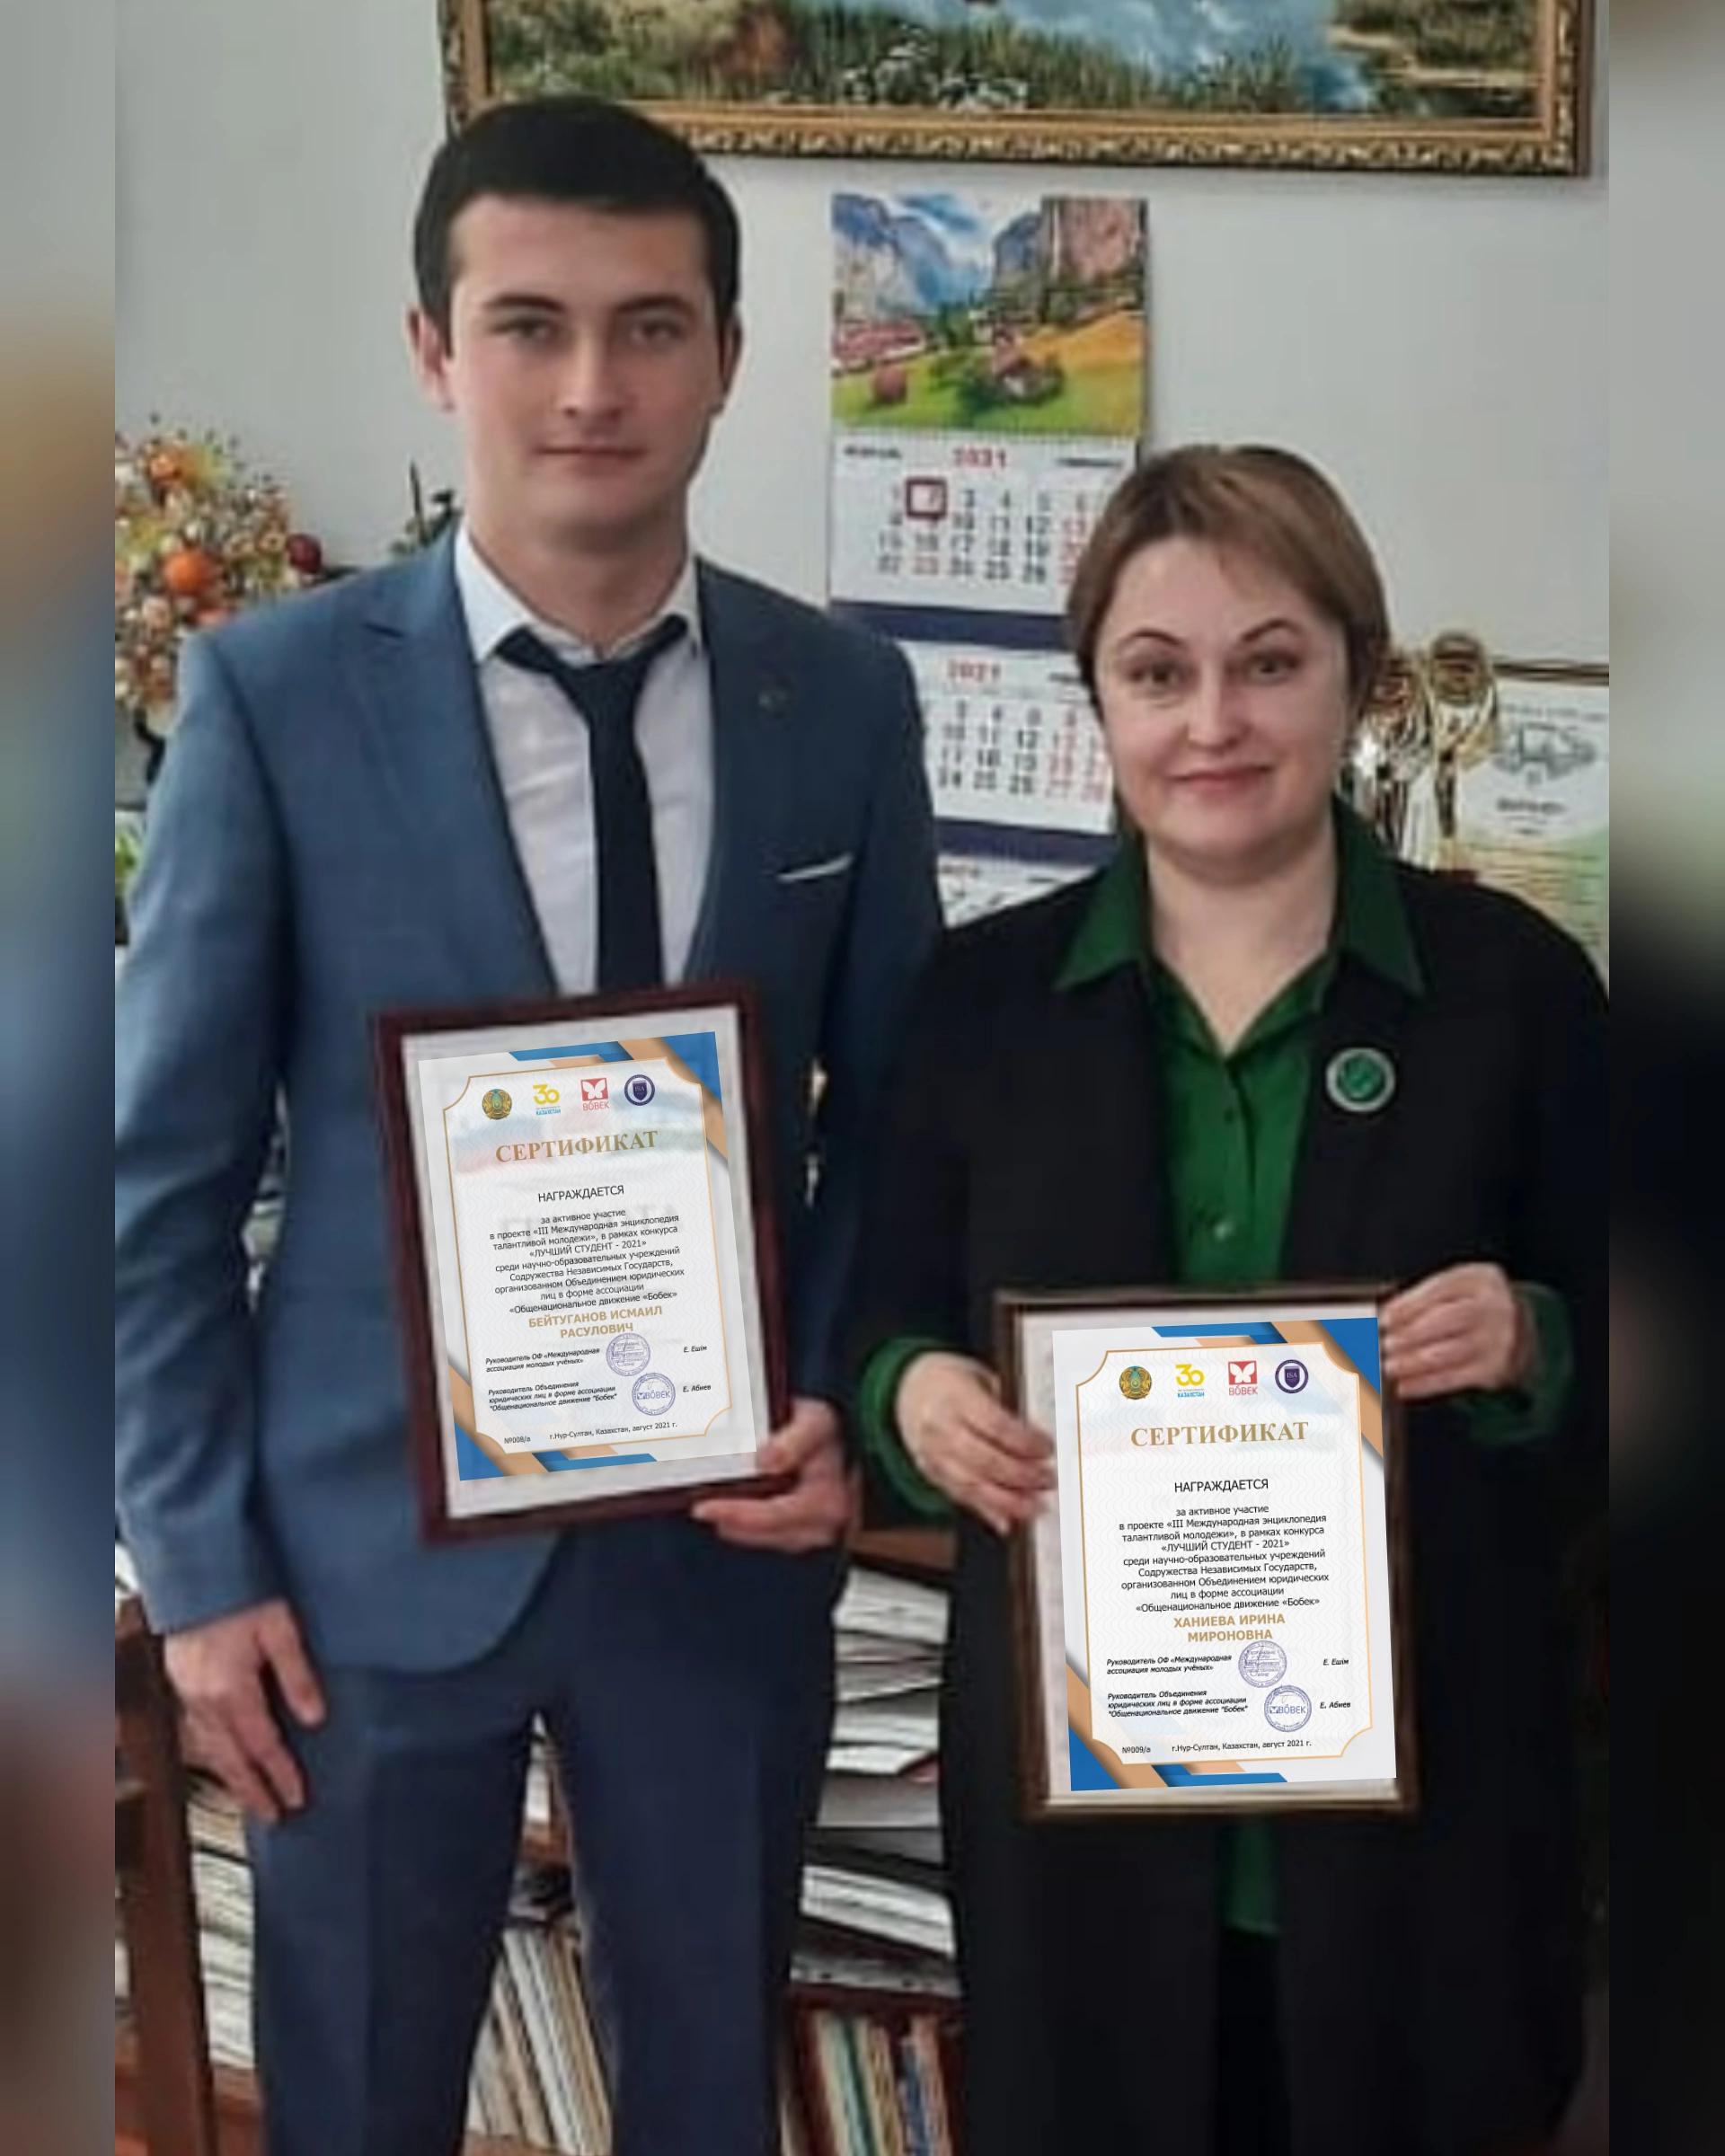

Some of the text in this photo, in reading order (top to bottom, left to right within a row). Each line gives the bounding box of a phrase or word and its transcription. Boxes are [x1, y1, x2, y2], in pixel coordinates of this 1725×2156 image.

[952, 446, 1006, 468] 2021
[494, 1129, 659, 1163] СЕРТИФИКАТ
[537, 1184, 624, 1203] НАГРАЖДАЕТСЯ
[552, 1213, 591, 1224] активное
[592, 1208, 626, 1221] участие
[496, 1229, 531, 1241] проекте
[550, 1221, 618, 1234] Международная
[619, 1215, 679, 1227] энциклопедия
[492, 1237, 546, 1250] талантливой
[547, 1234, 598, 1245] молодежи»,
[607, 1229, 639, 1241] рамках
[639, 1225, 678, 1236] конкурса
[528, 1245, 572, 1258] «ЛУЧШИЙ
[573, 1241, 613, 1254] СТУДЕНТ
[621, 1239, 647, 1250] 2021»
[494, 1245, 680, 1274] среди научно-образовательных учреждений
[509, 1259, 673, 1282] Содружества Независимых Государств,
[494, 1268, 685, 1295] организованном Объединением юридических
[540, 1292, 557, 1301] лиц
[564, 1287, 594, 1299] форме
[595, 1283, 645, 1295] ассоциации
[509, 1291, 677, 1314] «Общенациональное движение «Бобек»
[527, 1304, 663, 1329] БЕЙТУГАНОВ ИСМАИЛ
[559, 1321, 633, 1339] РАСУЛОВИЧ
[1130, 1421, 1309, 1447] СЕРТИФИКАТ
[1173, 1478, 1269, 1493] НАГРАЖДАЕТСЯ
[1188, 1507, 1231, 1516] активное
[1232, 1505, 1269, 1515] участие
[1127, 1521, 1164, 1532] проекте
[1185, 1517, 1260, 1529] Международная
[1261, 1515, 1327, 1525] энциклопедия
[1121, 1531, 1181, 1542] талантливой
[1182, 1531, 1238, 1541] молодежи»,
[1248, 1528, 1281, 1539] рамках
[1283, 1526, 1325, 1537] конкурса
[1160, 1541, 1208, 1552] «ЛУЧШИЙ
[1209, 1539, 1253, 1551] СТУДЕНТ
[1261, 1538, 1290, 1549] 2021»
[1122, 1549, 1326, 1568] среди научно-образовательных учреждений
[1137, 1562, 1317, 1578] Содружества Независимых Государств,
[1120, 1574, 1330, 1591] организованном Объединением юридических
[1170, 1591, 1189, 1600] лиц
[1197, 1589, 1229, 1600] форме
[1230, 1587, 1285, 1597] ассоциации
[1135, 1596, 1320, 1613] «Общенациональное движение «Бобек»
[1173, 1613, 1286, 1629] ХАНИЕВА ИРИНА
[1187, 1628, 1273, 1643] МИРОНОВНА
